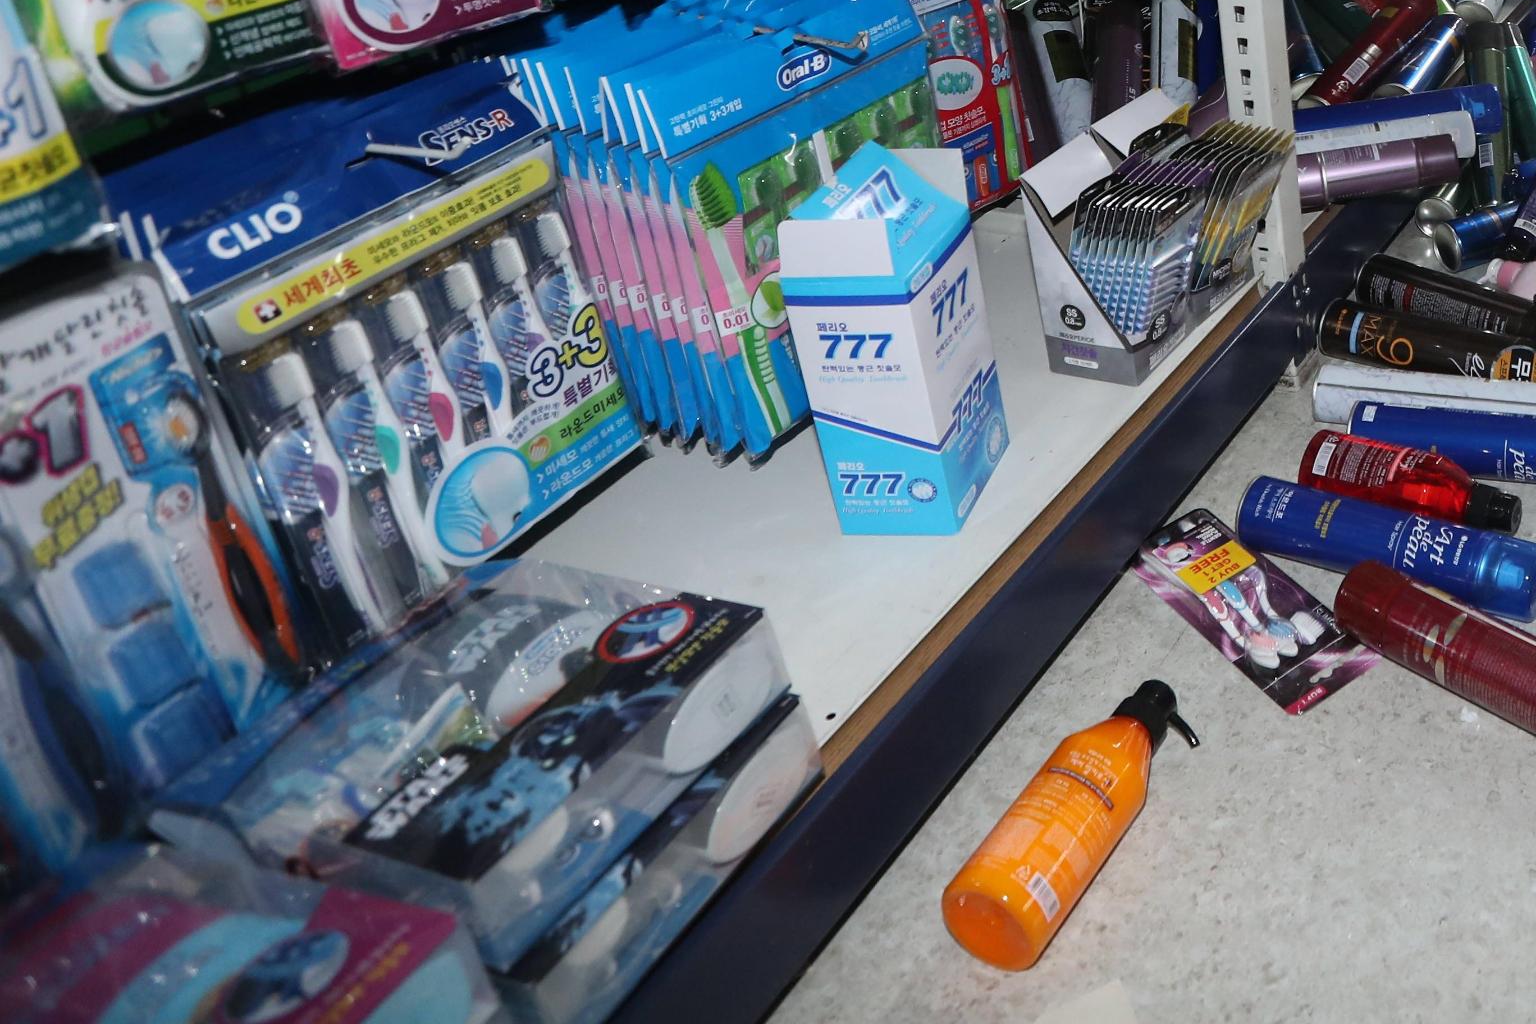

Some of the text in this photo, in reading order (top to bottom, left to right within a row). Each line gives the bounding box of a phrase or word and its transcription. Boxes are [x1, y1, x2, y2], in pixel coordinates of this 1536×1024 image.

[782, 53, 827, 85] Oral-B
[710, 98, 743, 122] 3+3개입
[207, 201, 302, 260] CLIO
[283, 258, 363, 308] 세계최초
[932, 266, 969, 337] 777
[1065, 307, 1077, 317] SS
[723, 312, 749, 329] 0.01
[816, 322, 848, 333] 페리오
[1361, 313, 1384, 355] MAX
[531, 302, 609, 399] 3+3
[819, 333, 893, 360] 777
[1377, 334, 1414, 366] 9
[546, 449, 579, 476] 미세모
[551, 458, 594, 493] 라운드모
[839, 472, 905, 497] 777
[1402, 516, 1432, 569] peau
[1424, 529, 1434, 550] de
[1430, 526, 1454, 566] Art
[1189, 548, 1231, 575] FREE
[1207, 561, 1241, 585] BUY 2
[1211, 555, 1233, 573] GET
